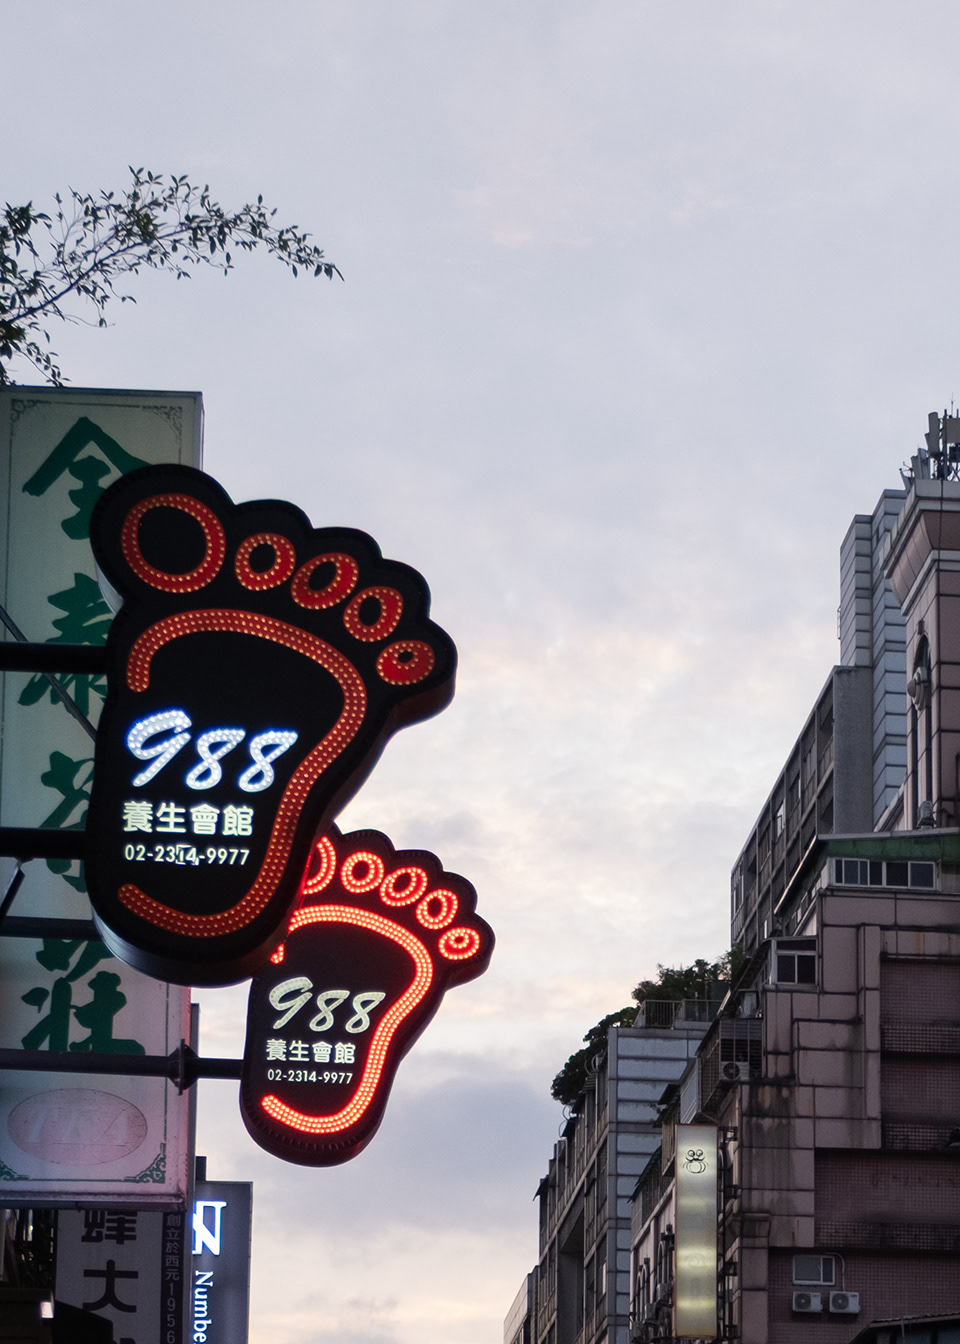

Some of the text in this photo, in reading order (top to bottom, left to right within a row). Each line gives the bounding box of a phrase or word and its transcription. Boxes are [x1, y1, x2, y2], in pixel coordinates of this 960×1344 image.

[126, 709, 299, 792] 988
[122, 801, 254, 836] 養生會館
[124, 844, 250, 866] 02-2314-9977
[268, 976, 386, 1034] 988
[266, 1039, 356, 1065] 養生會館
[267, 1069, 354, 1085] 02-2314-9977
